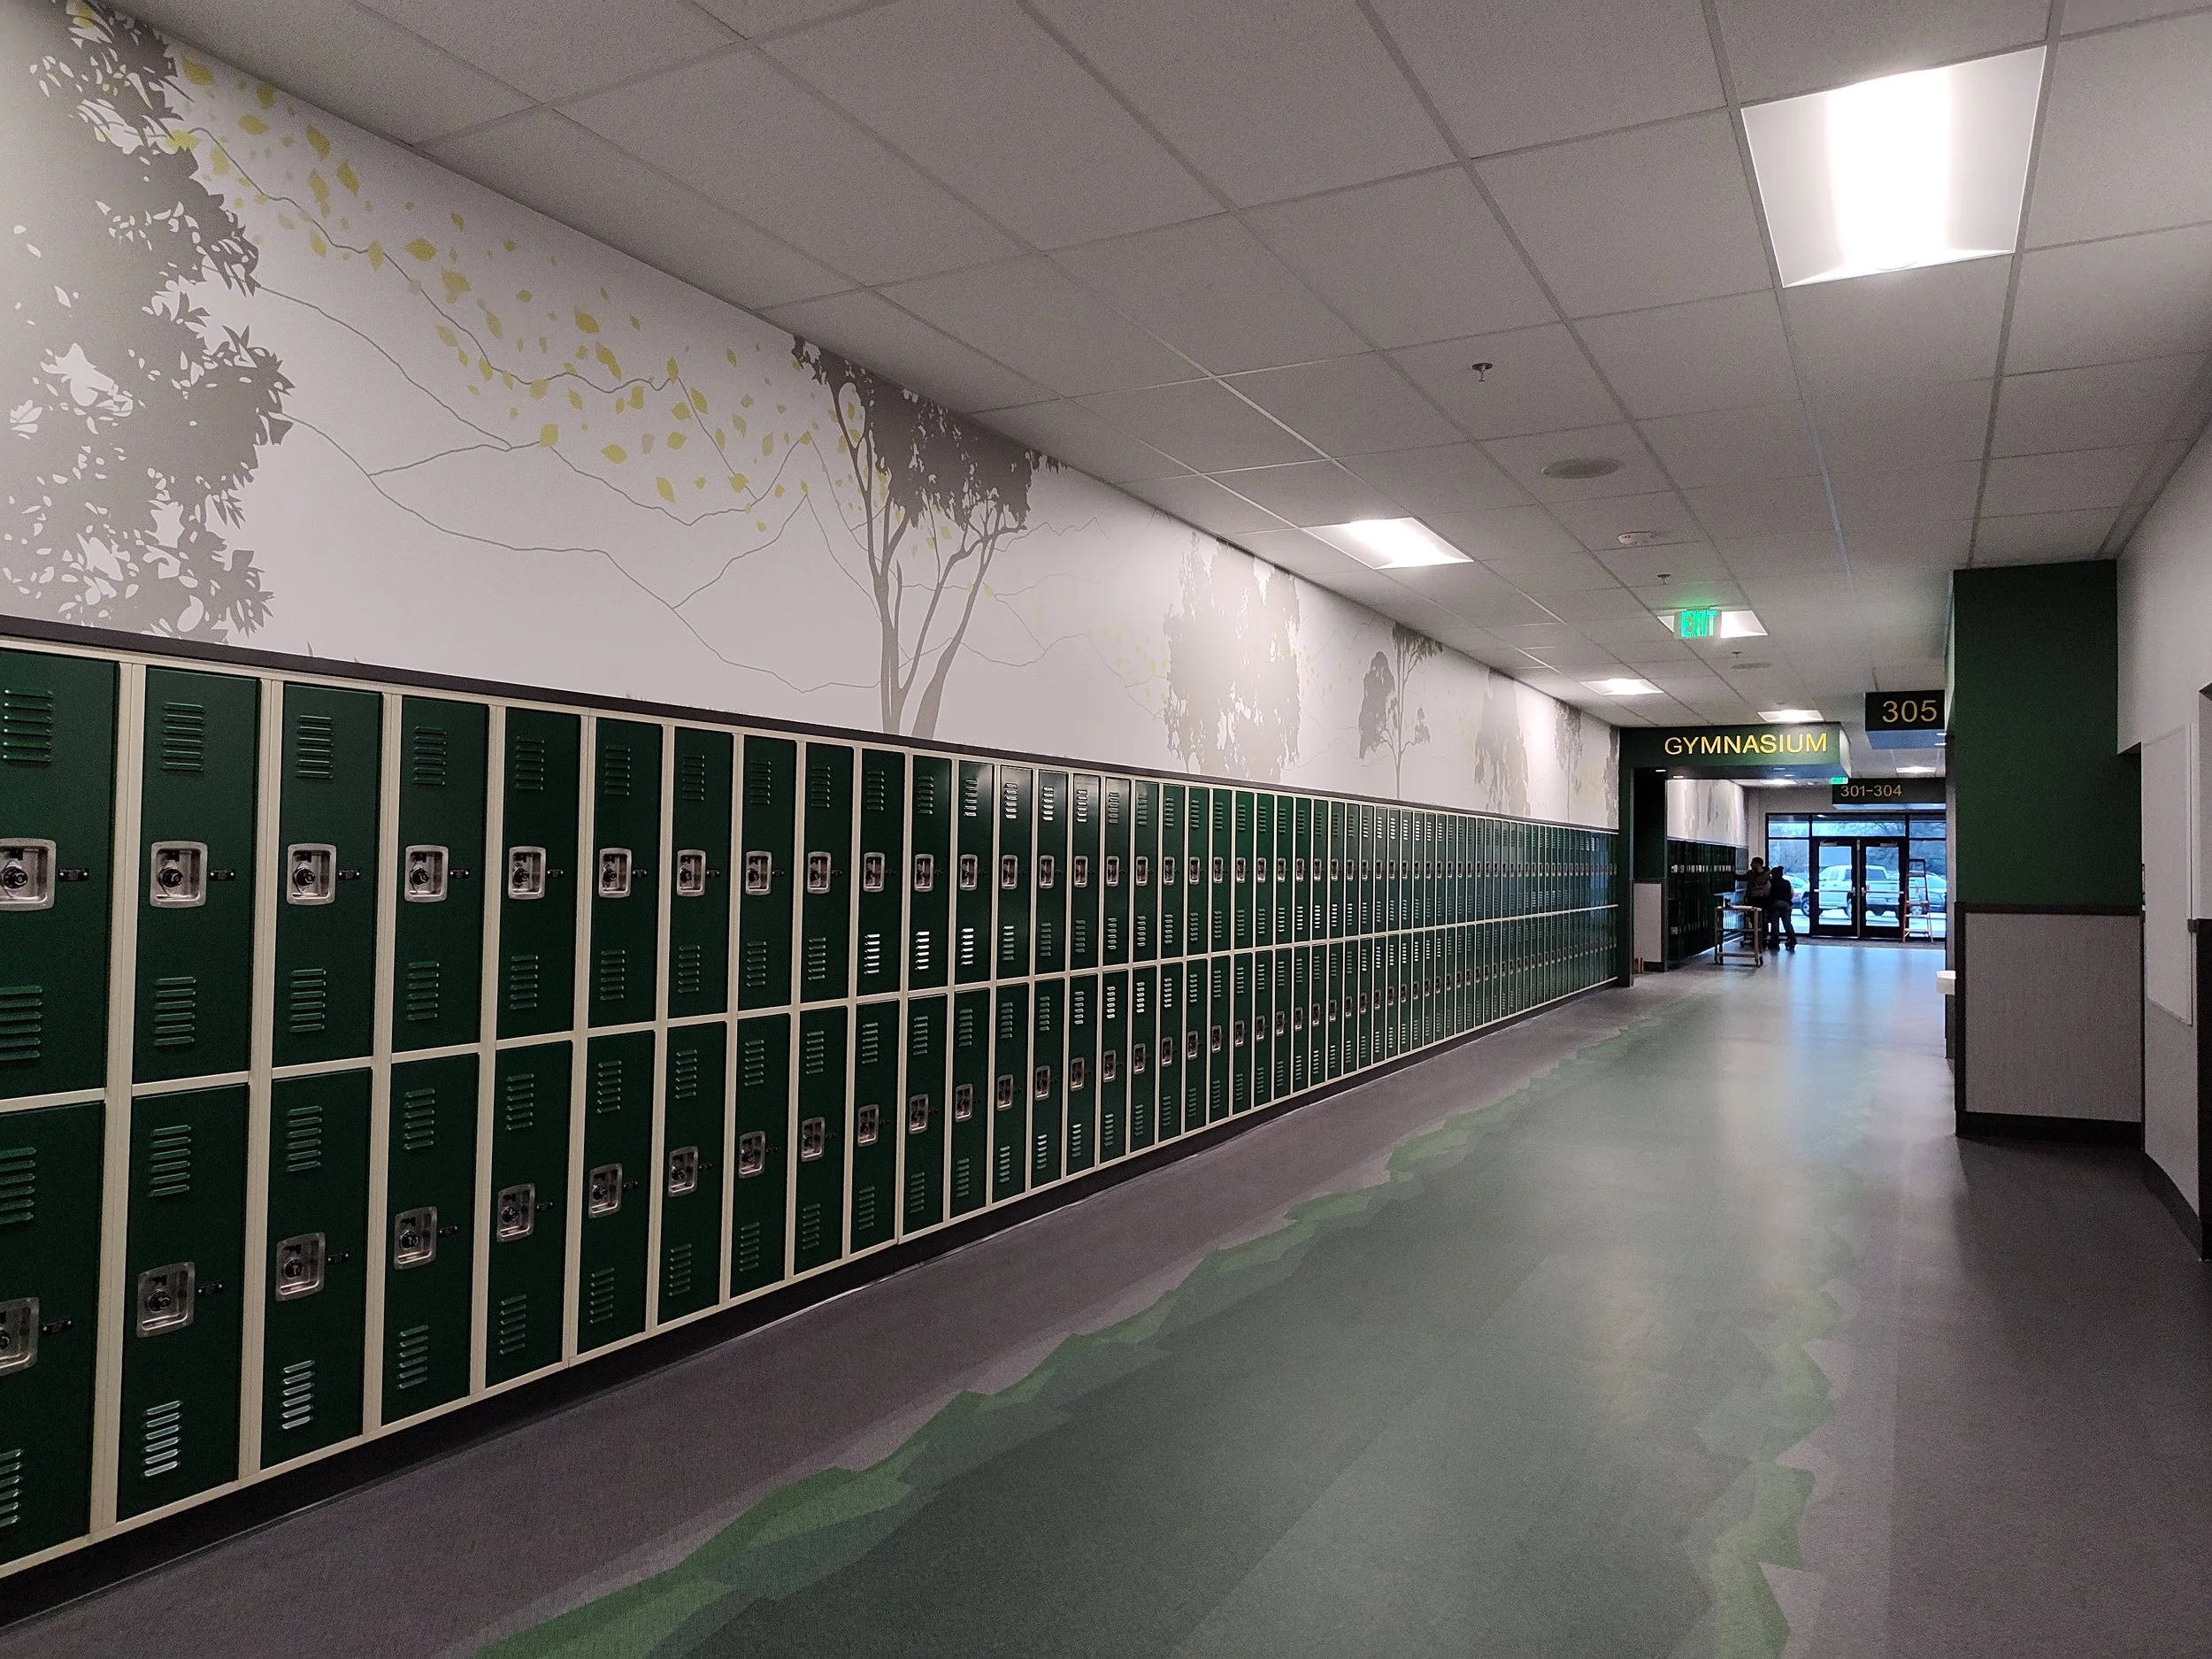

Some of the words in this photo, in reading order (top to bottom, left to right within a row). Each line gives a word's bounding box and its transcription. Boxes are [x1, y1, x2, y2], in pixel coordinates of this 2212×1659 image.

[1681, 611, 1717, 637] EXIT
[1882, 700, 1938, 723] 305
[1664, 733, 1827, 755] GYMNASIUM
[1840, 784, 1902, 797] 301-304
